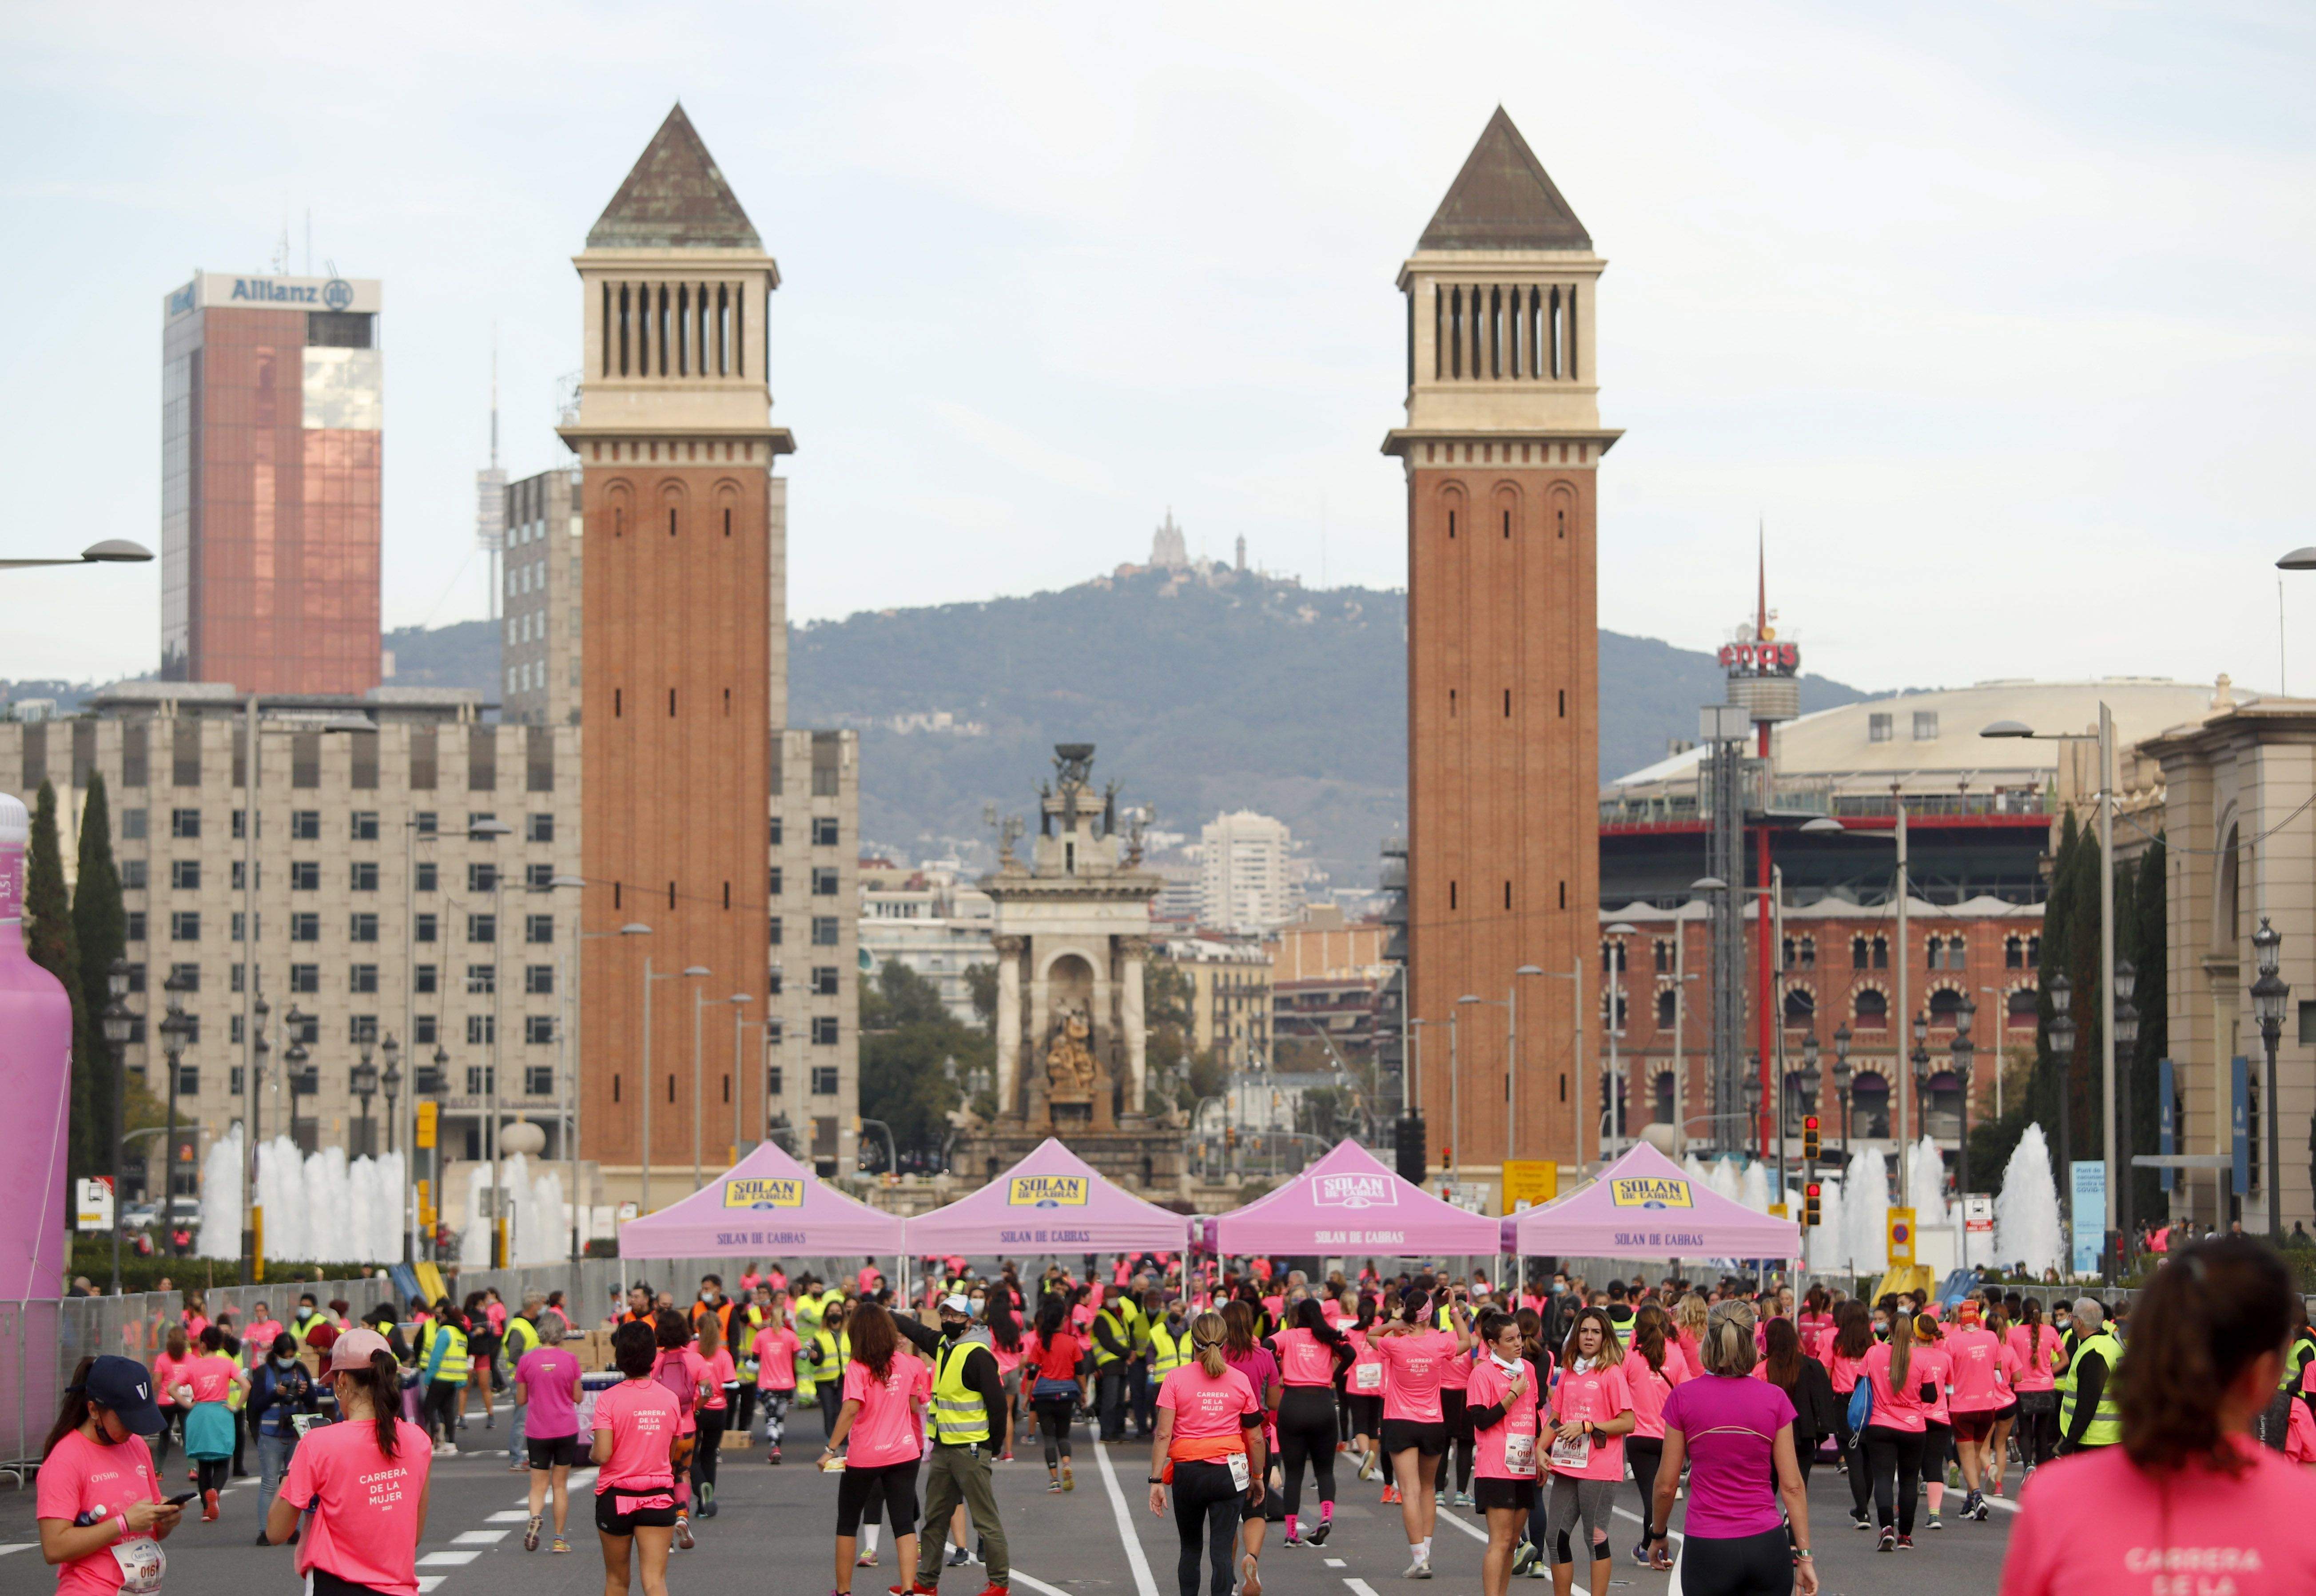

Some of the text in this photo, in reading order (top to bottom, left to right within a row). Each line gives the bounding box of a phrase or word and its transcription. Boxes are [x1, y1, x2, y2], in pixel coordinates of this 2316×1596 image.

[231, 279, 318, 303] Allianz
[1342, 1189, 1385, 1198] CABRAS
[752, 1232, 764, 1243] DE
[768, 1231, 806, 1244] CABRAS
[1036, 1231, 1047, 1242] DE
[1051, 1231, 1090, 1242] CABRAS
[1349, 1231, 1362, 1243] DE
[1365, 1231, 1405, 1243] CABRAS
[1649, 1234, 1661, 1245] DE
[1665, 1234, 1703, 1246] CABRAS
[91, 1471, 119, 1483] OYSHO
[359, 1467, 408, 1484] CARRERA
[370, 1481, 399, 1494] DE LA
[369, 1491, 402, 1505] MUJER
[2124, 1547, 2264, 1575] CARRERA
[2151, 1574, 2237, 1596] DE LA
